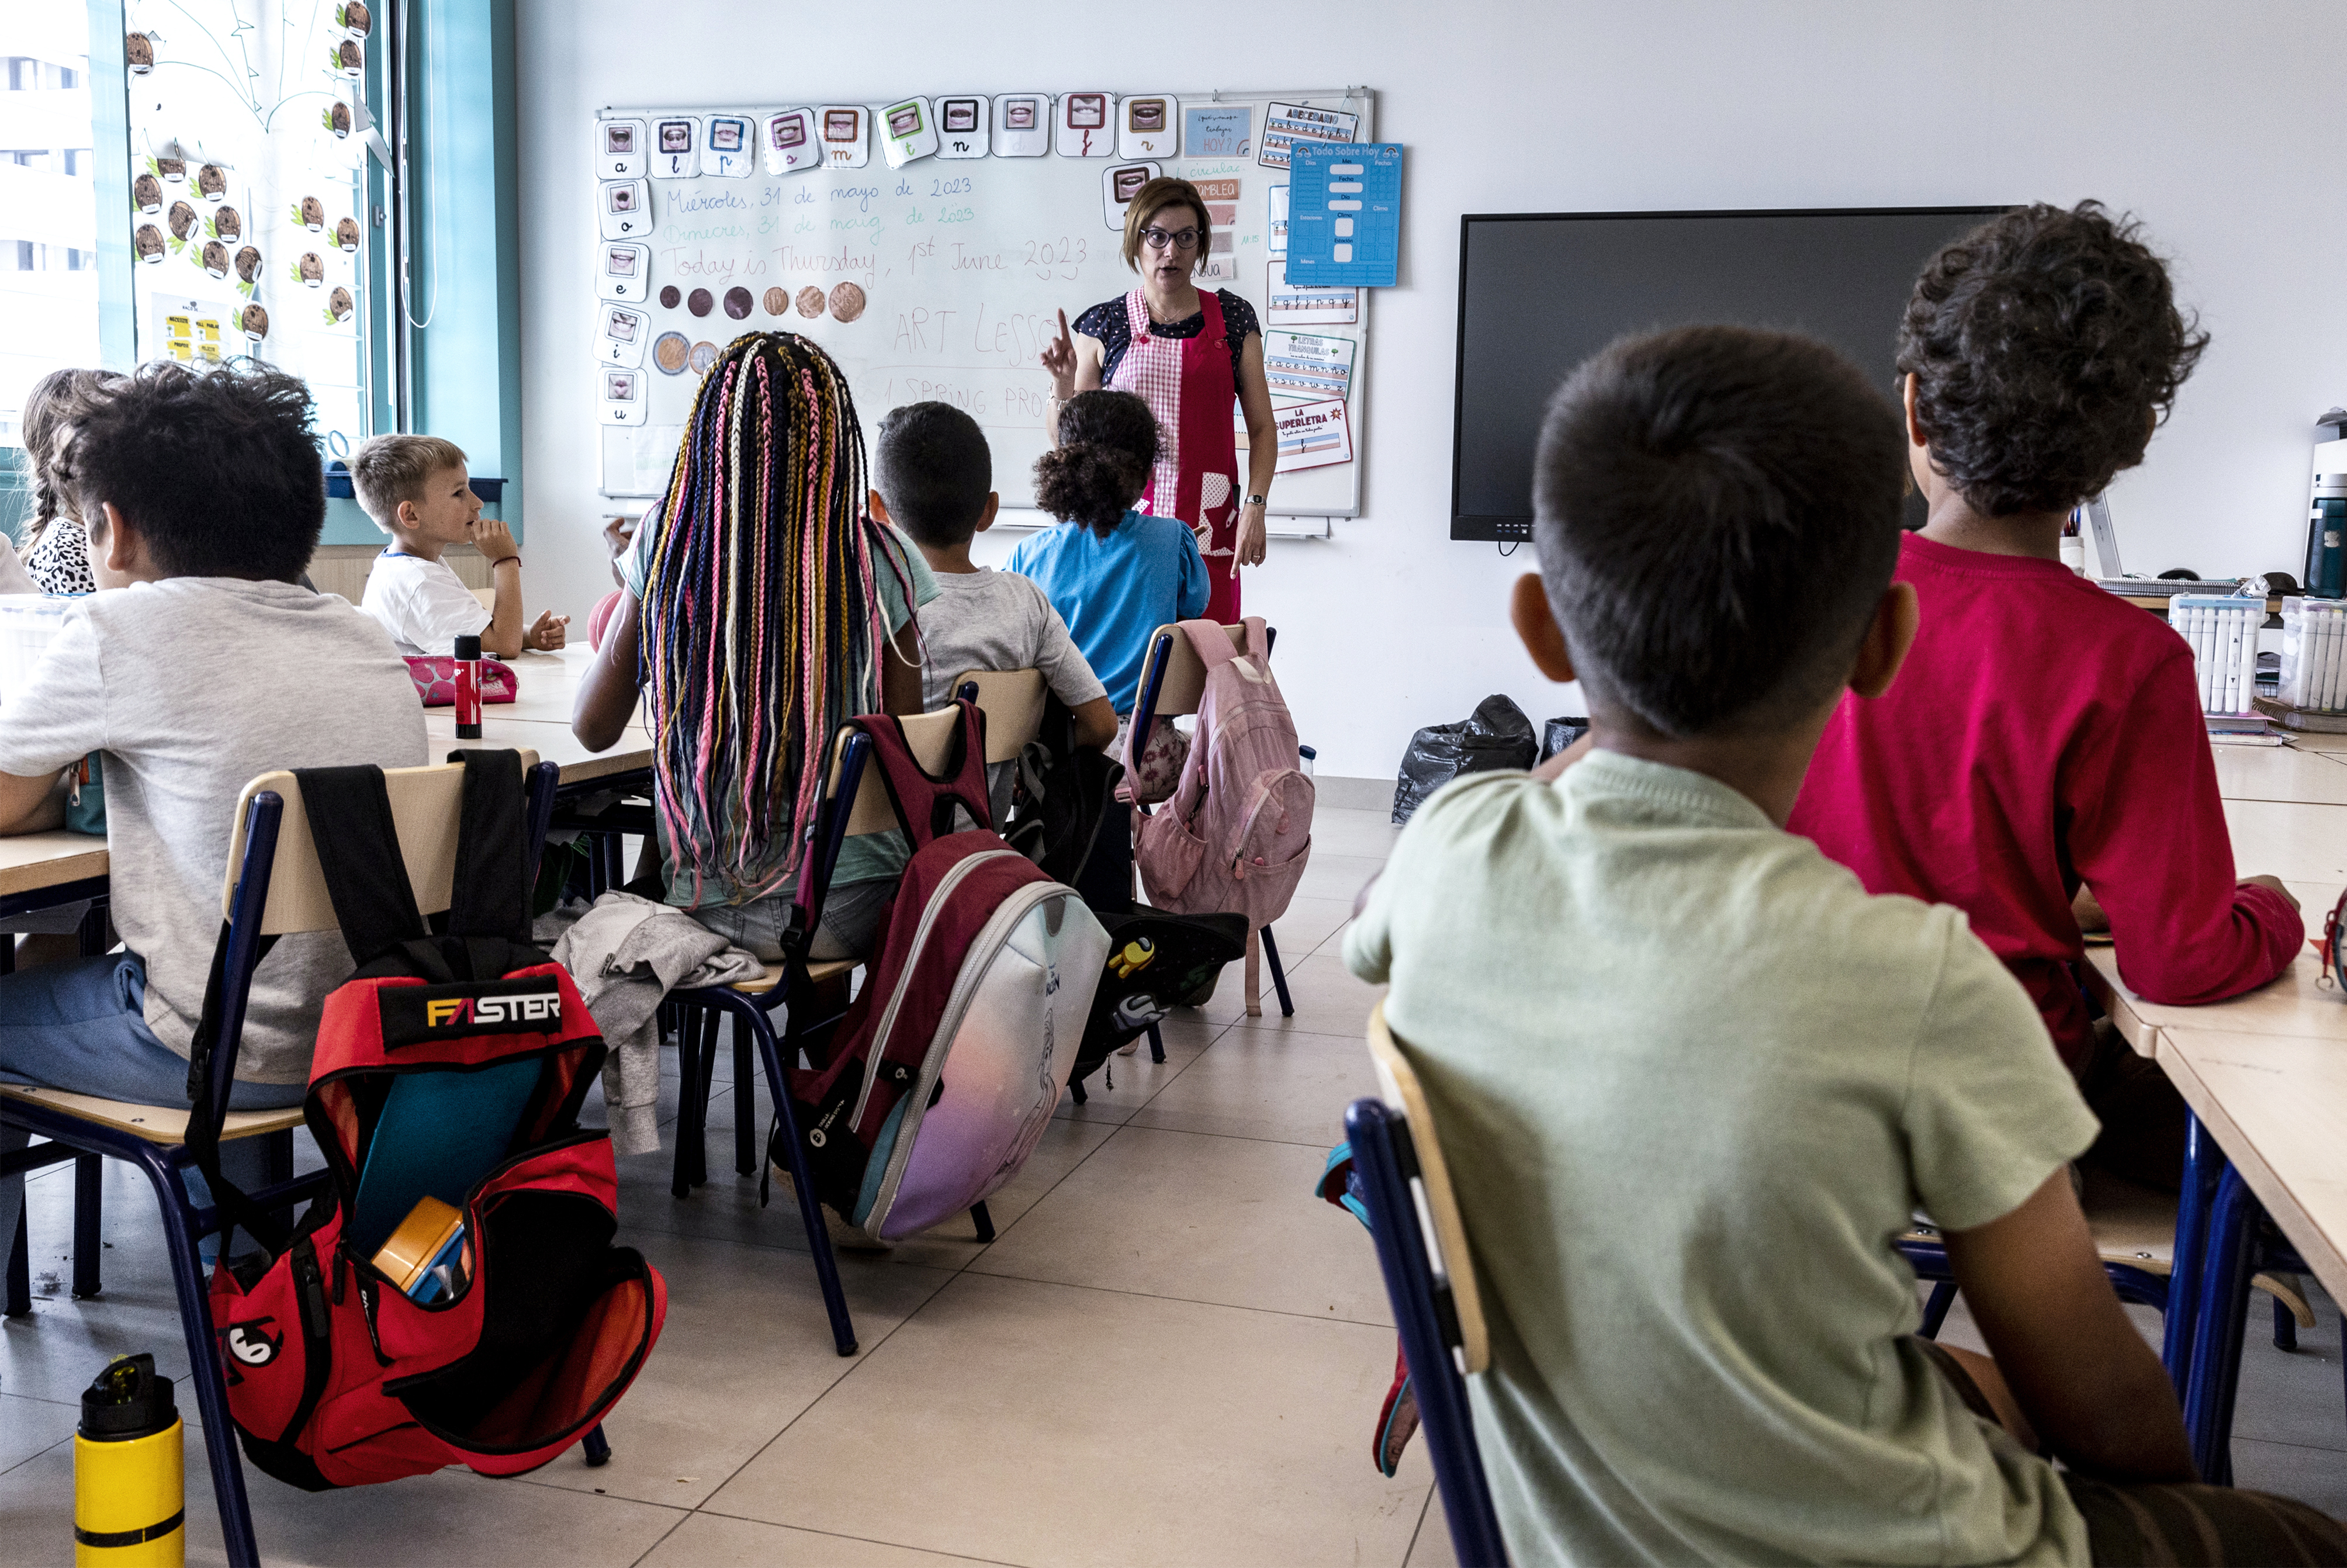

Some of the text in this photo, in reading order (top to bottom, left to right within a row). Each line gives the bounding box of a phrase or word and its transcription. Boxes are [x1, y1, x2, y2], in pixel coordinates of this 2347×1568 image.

[1286, 109, 1338, 124] ABECEDARIO
[905, 142, 915, 155] t
[953, 141, 970, 152] n
[1312, 147, 1380, 159] Todo Sobre Hoy
[831, 150, 851, 160] m
[615, 162, 628, 172] a
[760, 187, 780, 206] 31
[795, 185, 815, 204] de
[831, 188, 879, 212] mayo
[895, 178, 913, 196] de
[930, 178, 971, 196] 2023
[1196, 183, 1235, 196] AMBLEA
[758, 216, 779, 234] 31
[794, 214, 816, 234] de
[830, 214, 885, 245] maig
[906, 207, 925, 224] de
[938, 206, 974, 223] 2023
[660, 236, 1086, 289] Today is Thursday, 1st June 2023
[1189, 264, 1220, 279] NGUA
[615, 285, 626, 295] e
[894, 303, 1069, 366] ART LESSO
[1298, 336, 1323, 346] LETRAS
[612, 344, 621, 358] i
[1289, 344, 1330, 356] TRANQUILAS
[1005, 387, 1043, 417] PRO
[615, 410, 626, 420] u
[1295, 409, 1304, 417] LA
[427, 992, 560, 1027] FASTER
[818, 1112, 830, 1127] TROLLE
